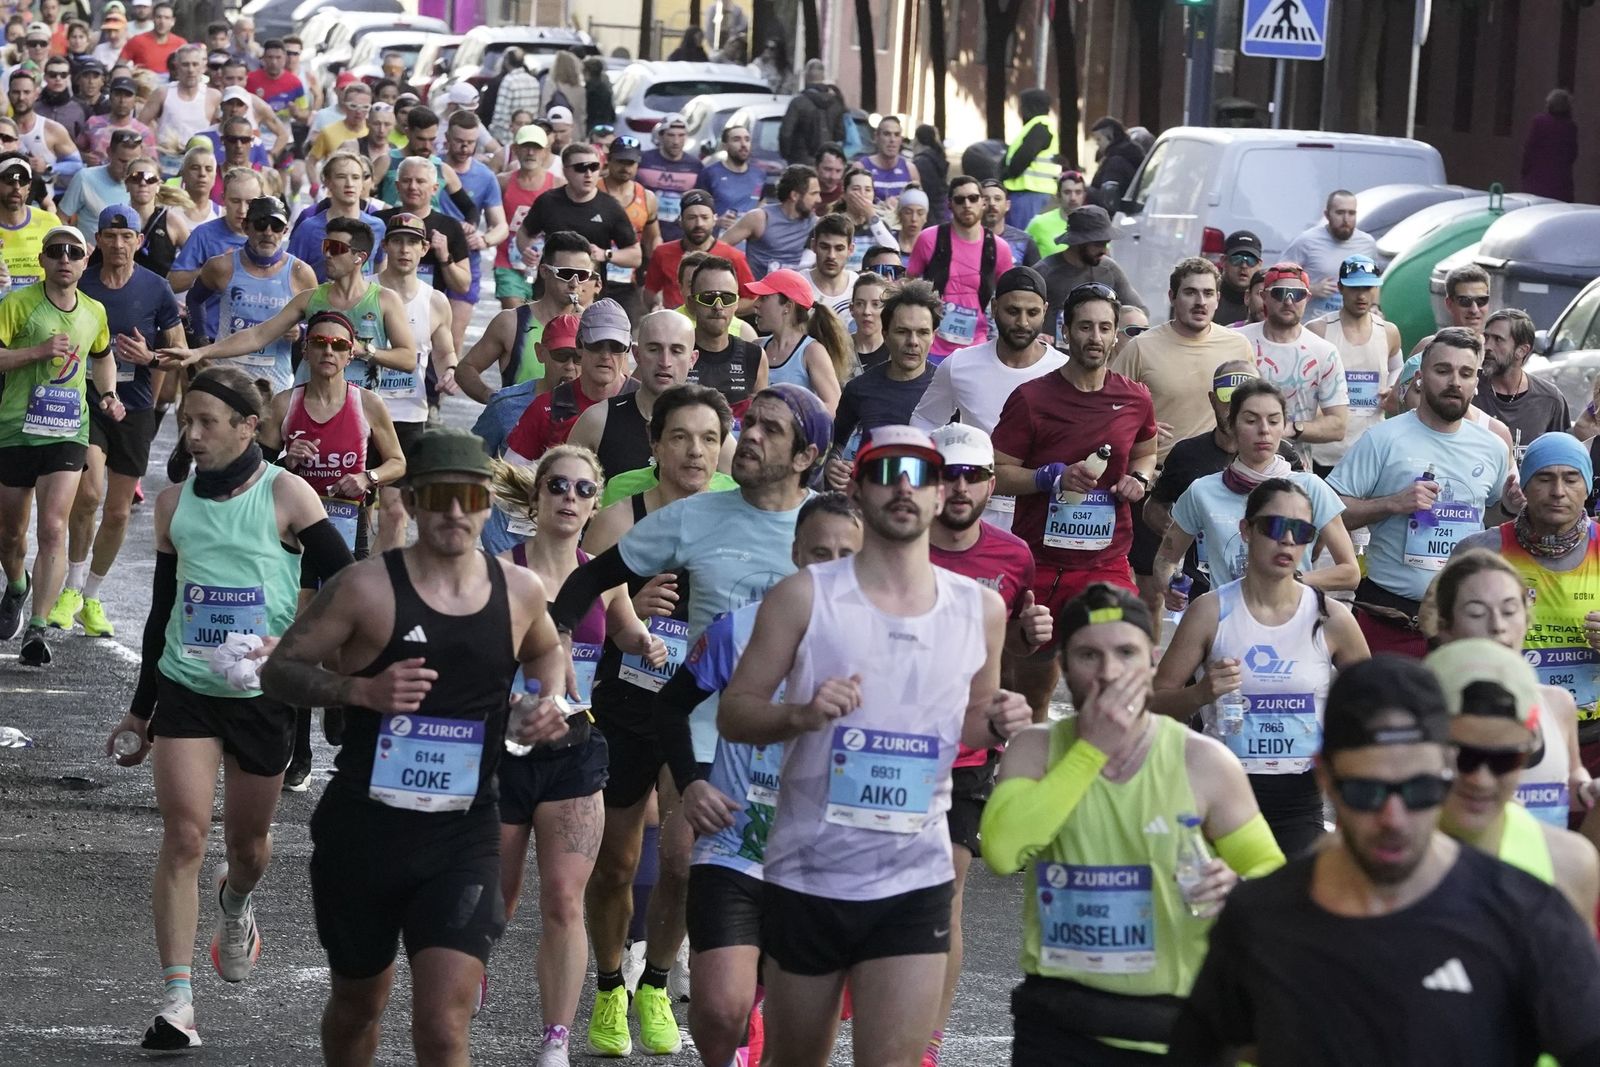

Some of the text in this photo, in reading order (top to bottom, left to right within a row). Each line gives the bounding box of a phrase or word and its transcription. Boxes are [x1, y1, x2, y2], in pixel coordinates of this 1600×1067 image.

[380, 377, 413, 388] NTOINE
[1347, 373, 1374, 381] ZURICH
[48, 389, 77, 398] ZURICH
[45, 403, 66, 413] 16220
[325, 505, 352, 516] URICH
[1072, 511, 1093, 520] 6347
[1050, 521, 1111, 536] RADOUAN
[1434, 528, 1453, 538] 7241
[208, 591, 256, 602] ZURICH
[210, 613, 235, 625] 6405
[1526, 634, 1563, 644] UERTO
[571, 647, 595, 658] RICH
[1547, 650, 1593, 663] ZURICH
[1549, 674, 1574, 686] 8342
[1256, 699, 1306, 710] ZURICH
[417, 722, 474, 739] ZURICH
[1258, 722, 1285, 733] 7865
[871, 735, 930, 753] ZURICH
[1248, 738, 1295, 755] LEIDY
[415, 750, 446, 765] 6144
[870, 764, 902, 780] 6931
[401, 767, 452, 790] COKE
[859, 784, 908, 808] AIKO
[1072, 870, 1140, 887] ZURICH
[1047, 922, 1147, 948] JOSSELIN
